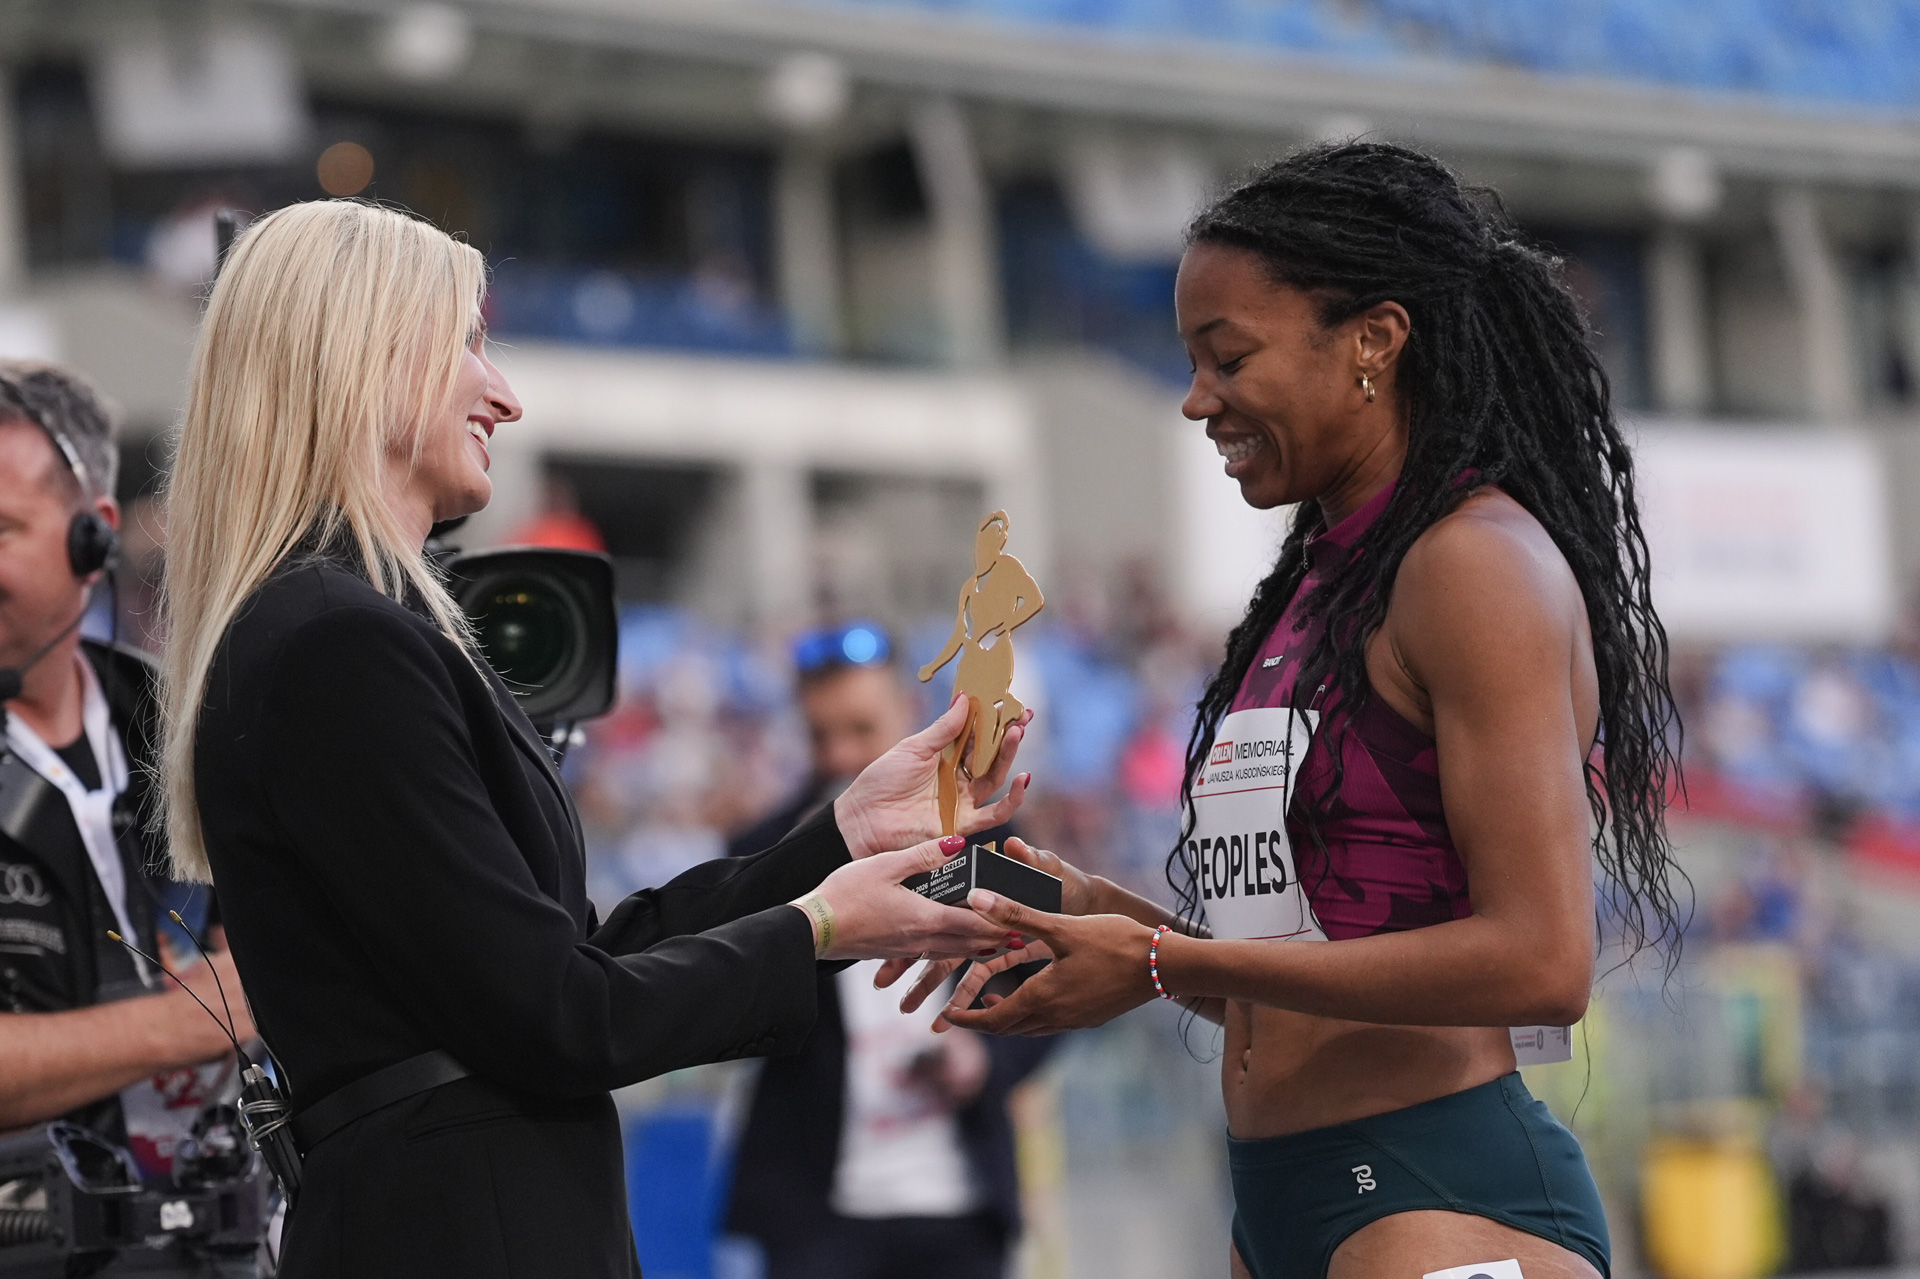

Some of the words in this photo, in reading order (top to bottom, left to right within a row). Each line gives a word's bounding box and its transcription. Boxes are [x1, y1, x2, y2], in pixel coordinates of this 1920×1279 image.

[1262, 655, 1283, 667] BANDIT
[1211, 743, 1233, 764] ORLEN
[1207, 770, 1233, 784] JANUSZA
[944, 857, 966, 873] ORLEN
[1188, 829, 1287, 900] PEOPLES
[930, 882, 950, 895] JANUSZA
